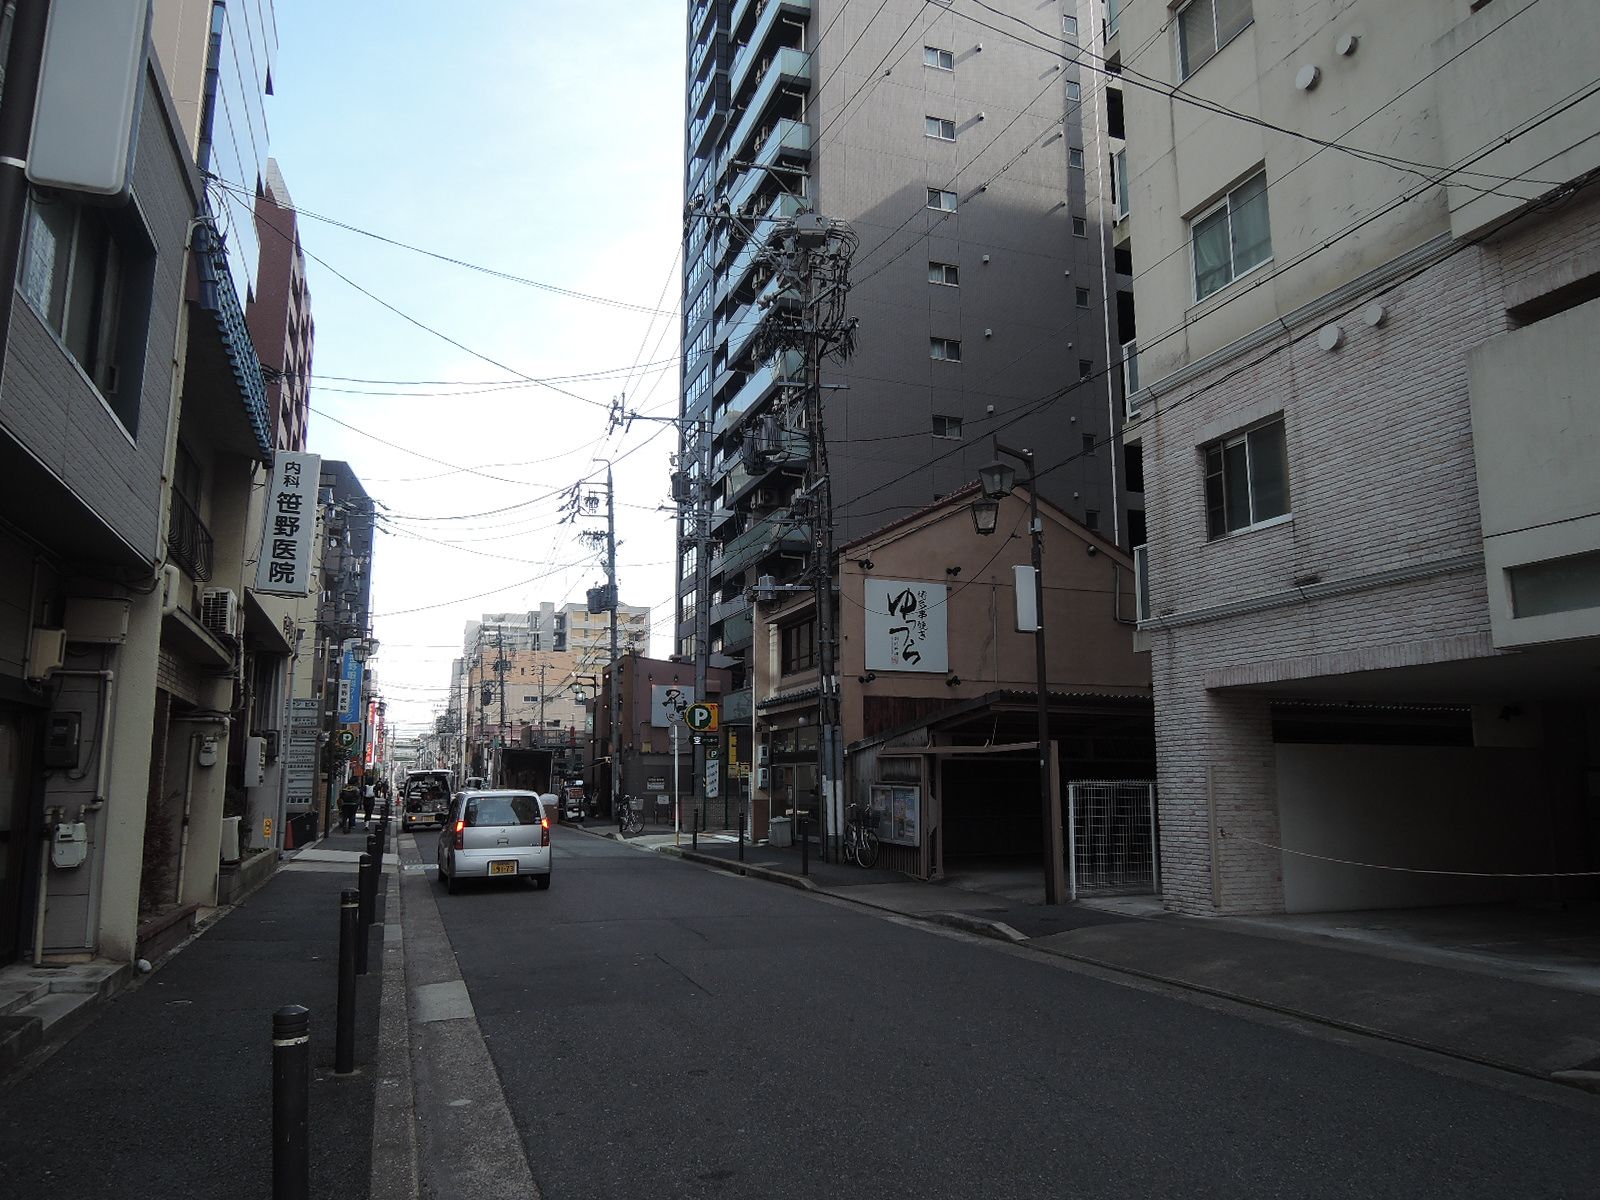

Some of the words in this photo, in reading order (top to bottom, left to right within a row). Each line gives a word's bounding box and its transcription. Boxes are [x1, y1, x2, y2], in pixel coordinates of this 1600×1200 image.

[283, 461, 301, 488] 内科
[269, 491, 303, 584] 笹野医院
[694, 708, 709, 727] P
[342, 733, 352, 745] P
